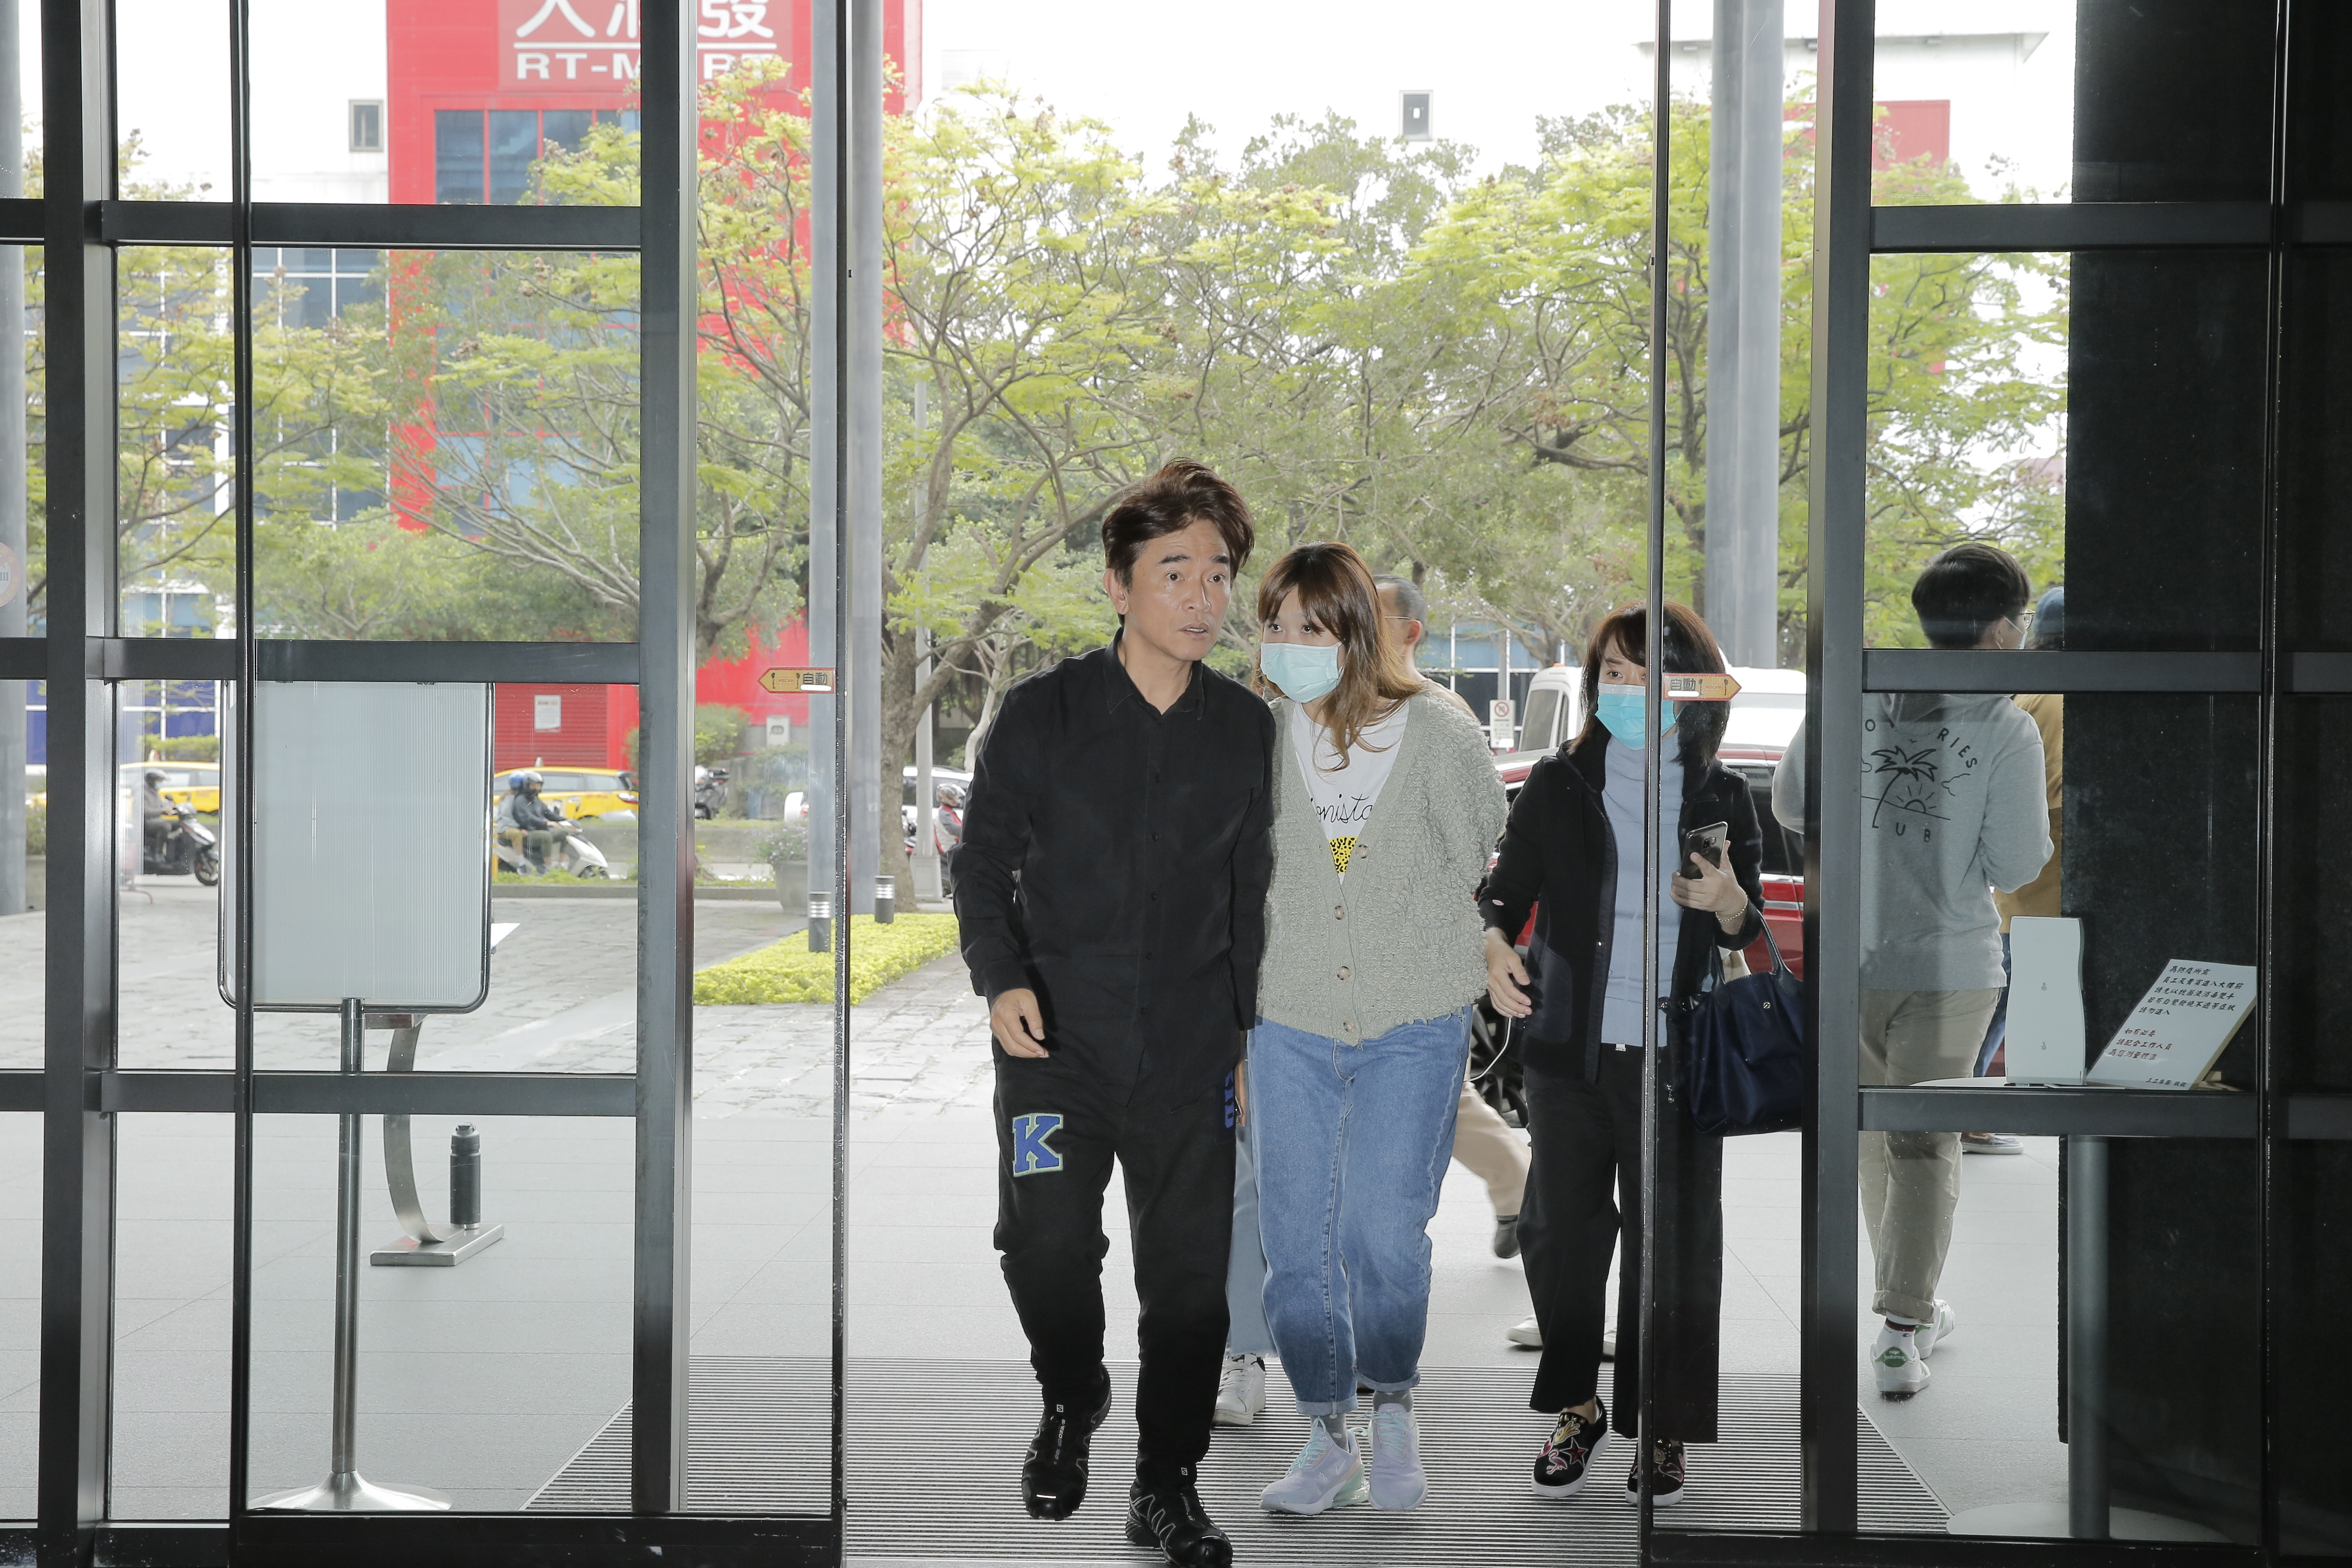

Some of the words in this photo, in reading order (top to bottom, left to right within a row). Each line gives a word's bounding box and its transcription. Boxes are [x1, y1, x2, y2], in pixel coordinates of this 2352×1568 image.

[517, 53, 773, 80] RT-MRT
[803, 673, 827, 685] 自動
[1670, 678, 1696, 691] 自動
[2139, 1007, 2169, 1015] 請勿進入
[2125, 1027, 2156, 1037] 如有必要
[2116, 1039, 2172, 1051] 請配合工作人員
[1012, 1113, 1063, 1177] K
